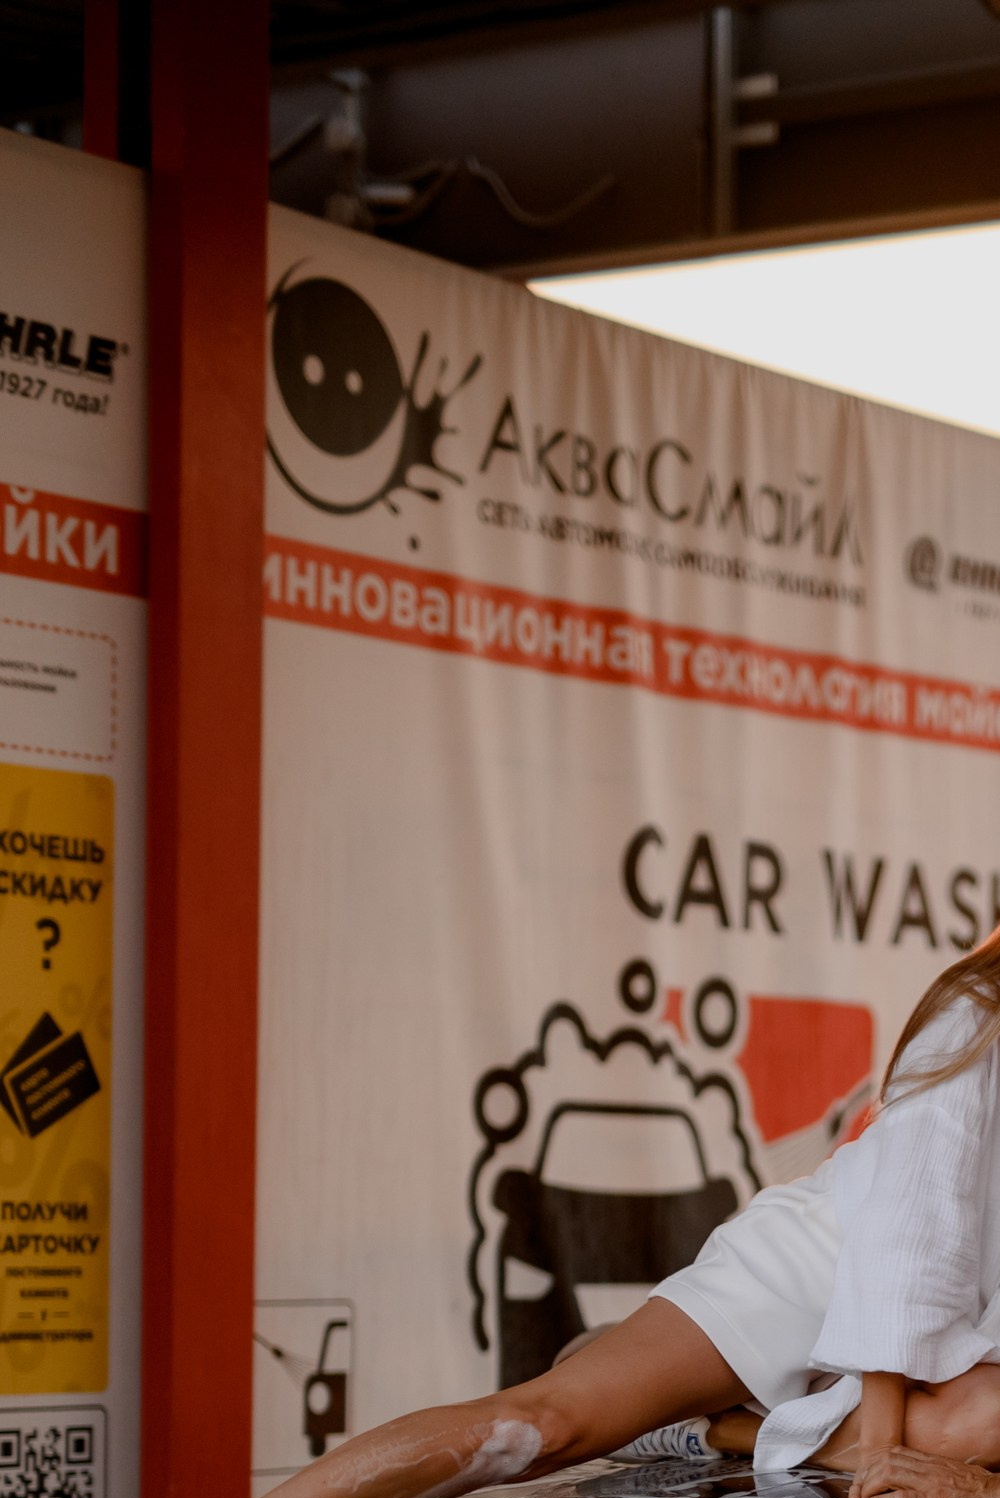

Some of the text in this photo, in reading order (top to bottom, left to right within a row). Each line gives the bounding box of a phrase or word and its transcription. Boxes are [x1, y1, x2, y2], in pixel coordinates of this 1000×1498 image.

[0, 370, 109, 417] 1927 года!
[480, 395, 864, 567] АкваСмайл
[0, 829, 105, 864] ХОЧЕШЬ
[621, 823, 784, 934] CAR
[36, 917, 61, 970] ?
[1, 1201, 89, 1221] ПОЛУЧИ
[0, 1235, 101, 1254] АРТОЧКУ
